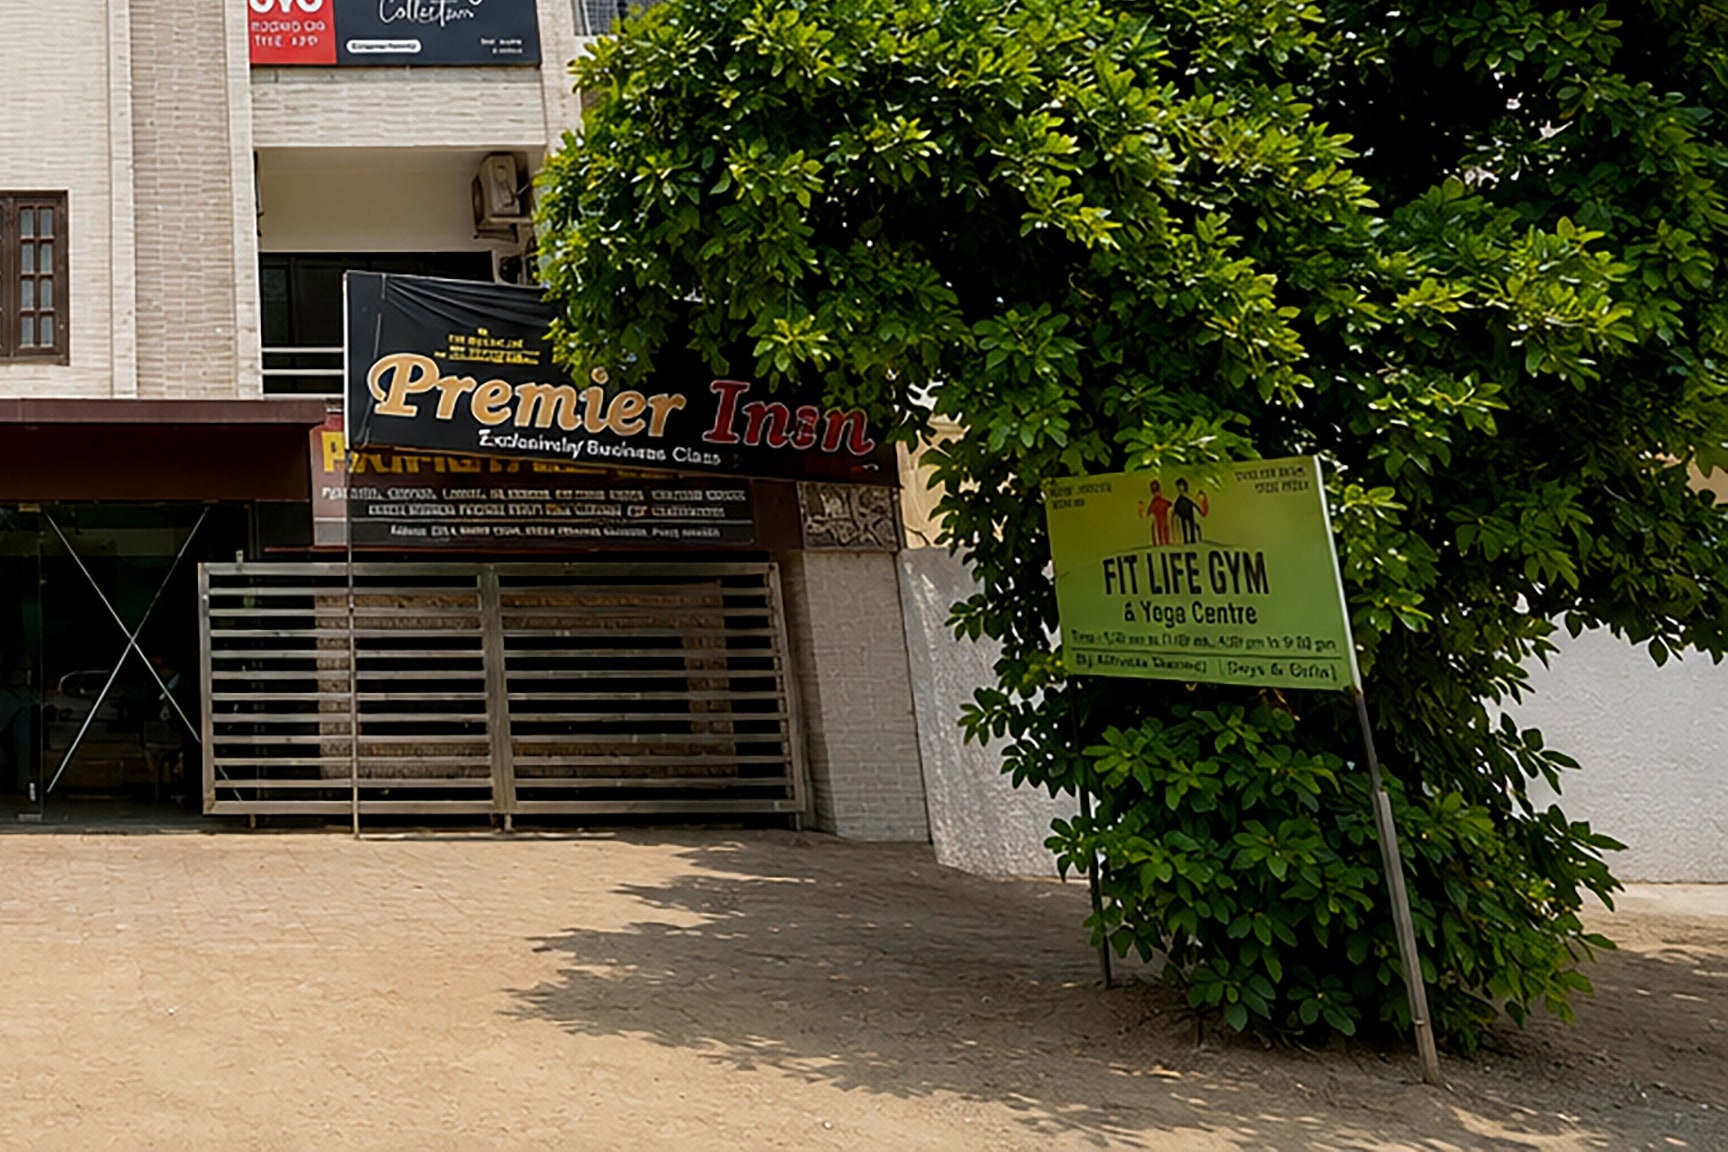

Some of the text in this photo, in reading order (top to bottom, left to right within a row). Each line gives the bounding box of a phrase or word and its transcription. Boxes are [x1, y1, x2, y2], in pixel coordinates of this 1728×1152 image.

[367, 353, 687, 438] Premier
[1103, 550, 1270, 595] FIT LIFE GYM
[1192, 601, 1258, 625] Centre
